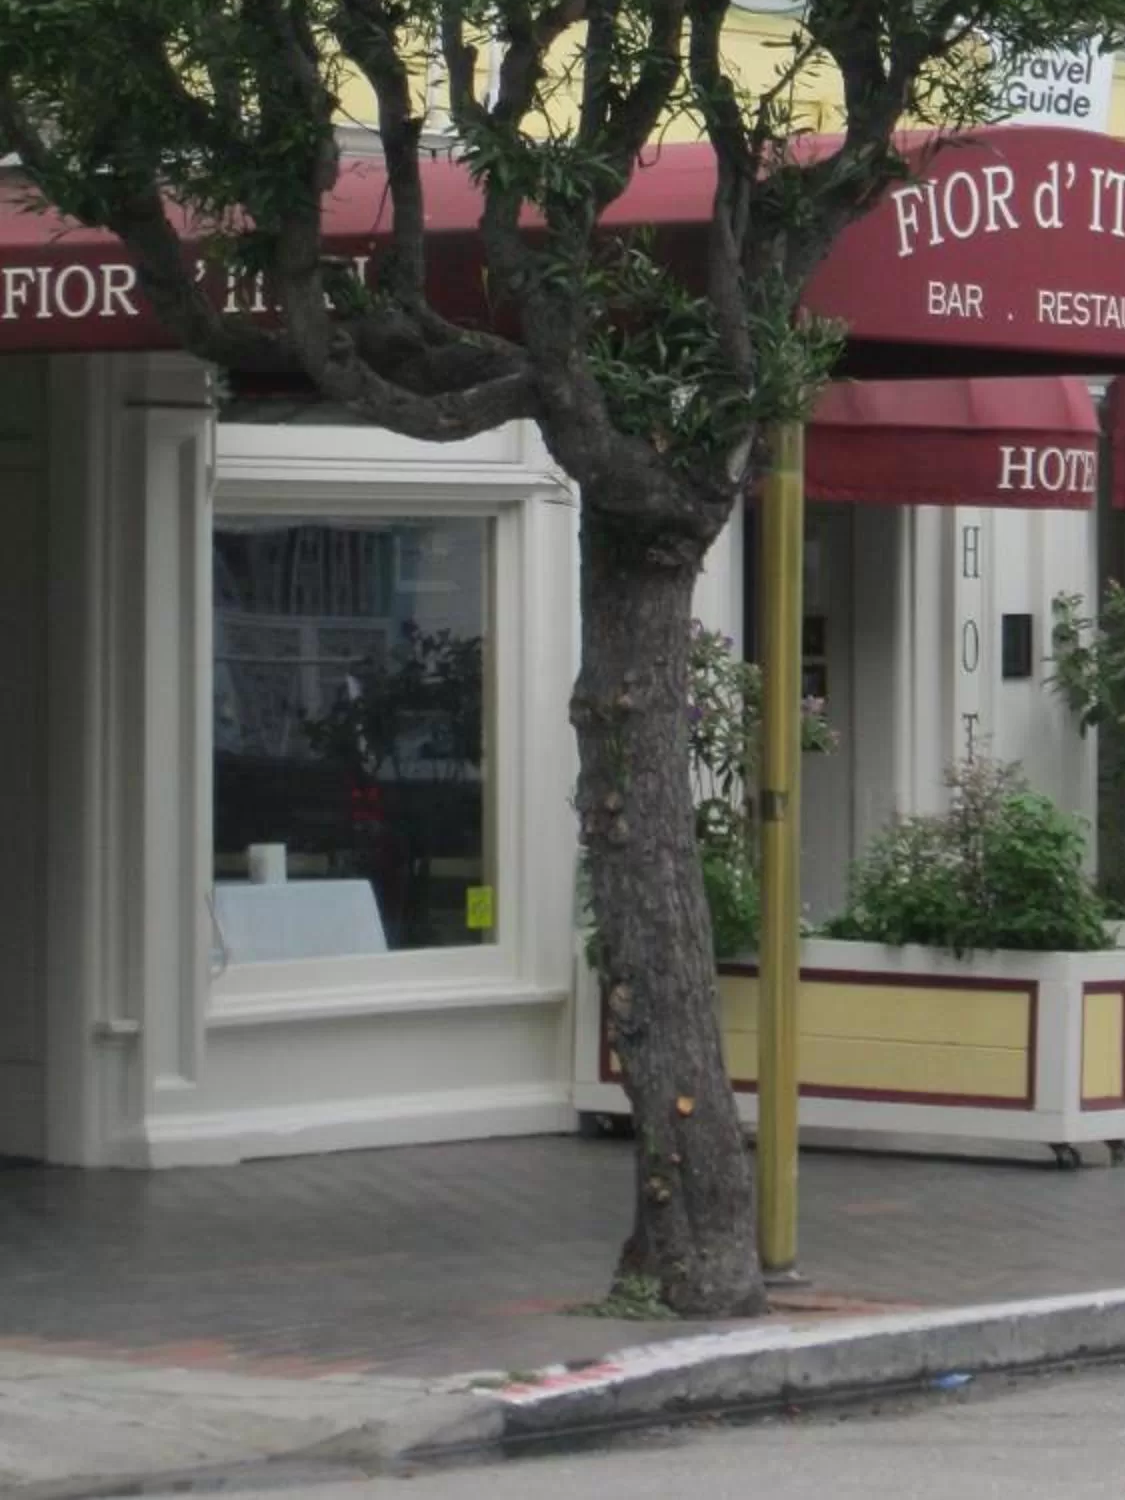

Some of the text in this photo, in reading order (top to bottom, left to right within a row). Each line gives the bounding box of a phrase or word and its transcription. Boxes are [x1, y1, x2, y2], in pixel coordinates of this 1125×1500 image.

[1011, 50, 1093, 84] ravel
[1007, 82, 1091, 117] Guide
[891, 166, 1019, 258] FIOR
[1, 263, 140, 320] FIOR
[928, 281, 984, 318] BAR
